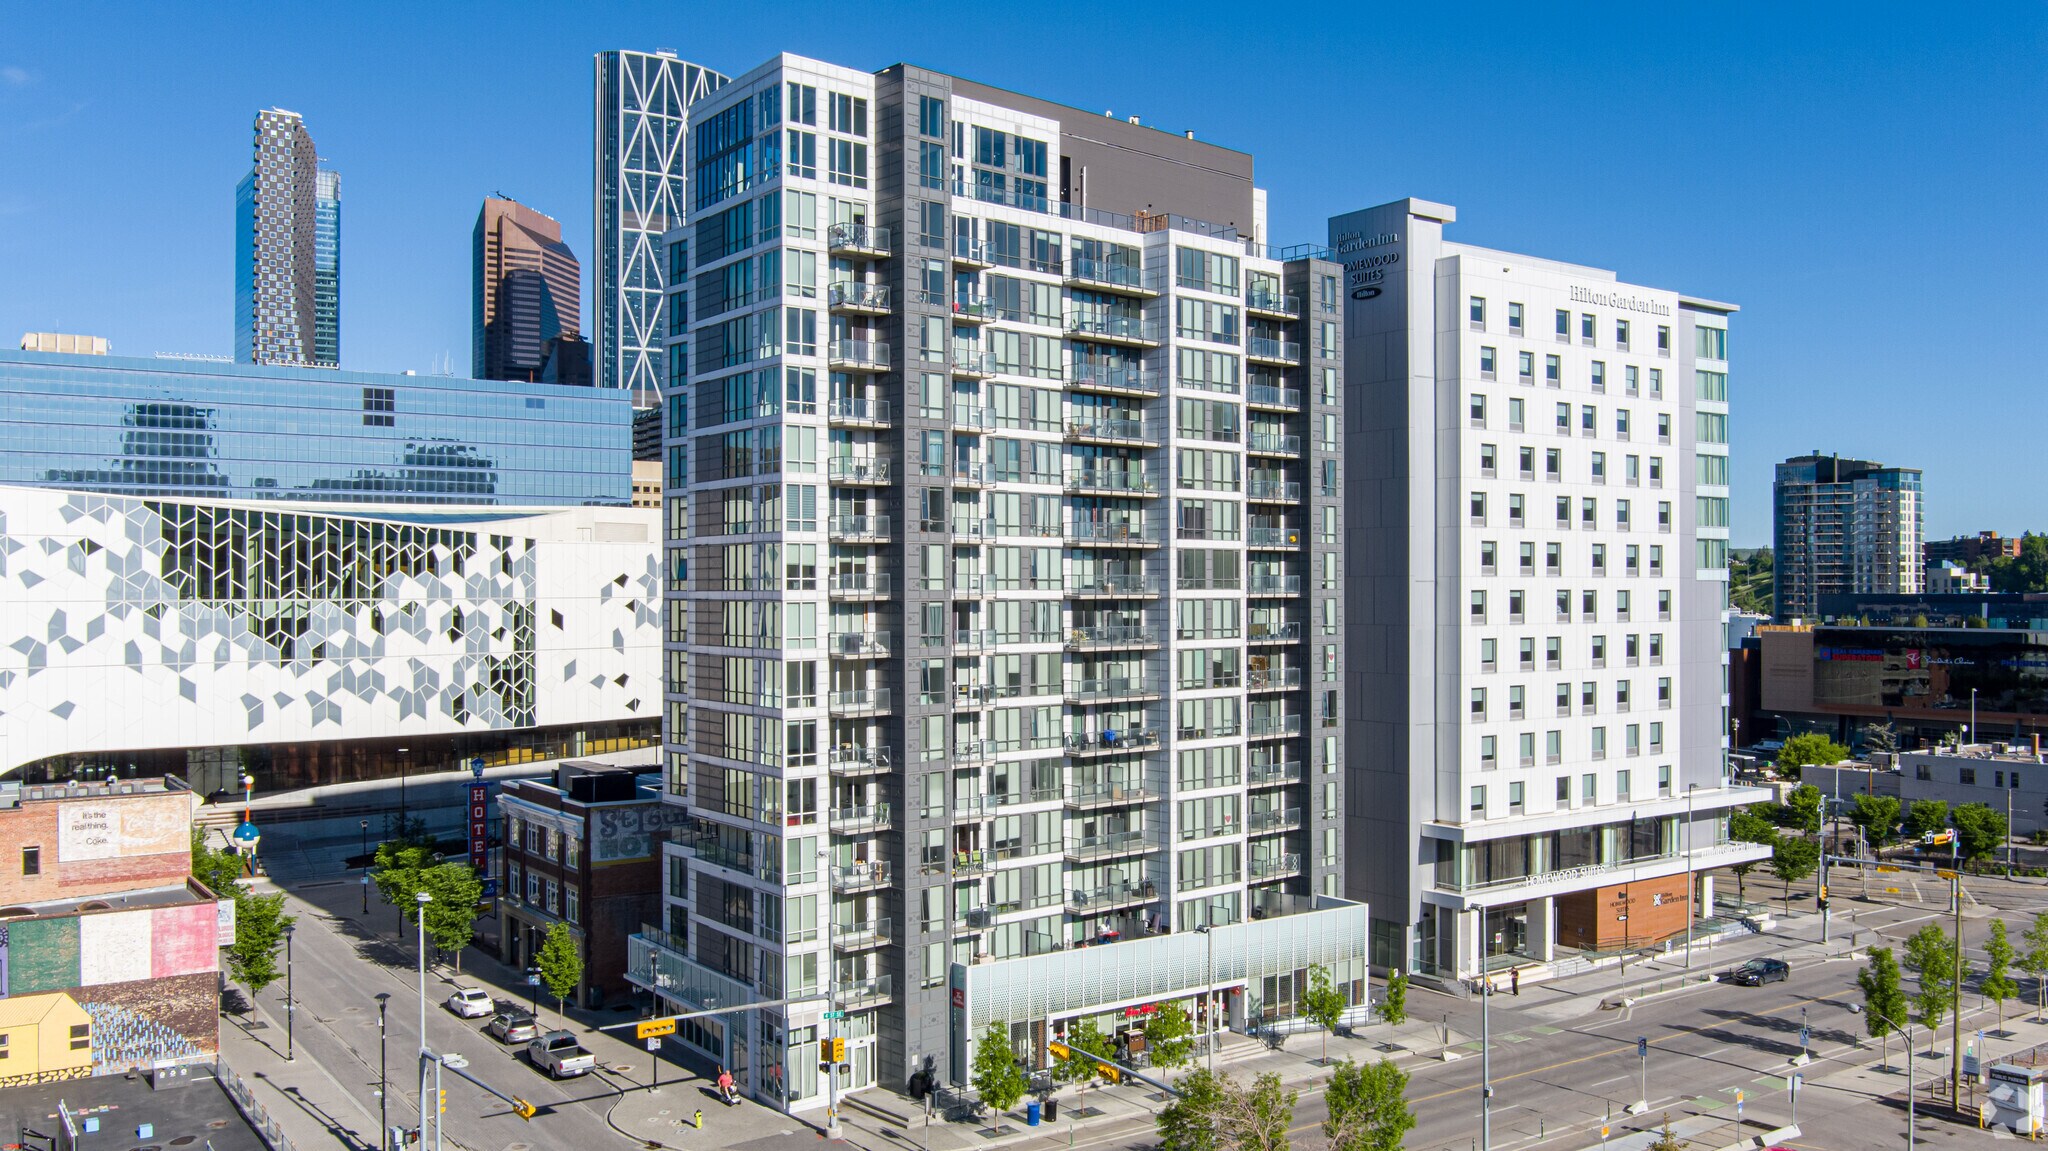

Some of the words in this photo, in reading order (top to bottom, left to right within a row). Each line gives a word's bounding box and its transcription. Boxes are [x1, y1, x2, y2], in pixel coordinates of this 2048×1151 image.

[1336, 238, 1375, 254] Garden
[1377, 233, 1399, 246] Inn
[1343, 252, 1399, 273] OMEWOOD
[1350, 268, 1383, 284] SUITES
[1570, 285, 1607, 306] Hilton
[1608, 292, 1649, 313] Garden
[1650, 299, 1670, 317] Inn
[1526, 869, 1578, 887] HOMEWOOD
[1581, 864, 1606, 878] SUITES
